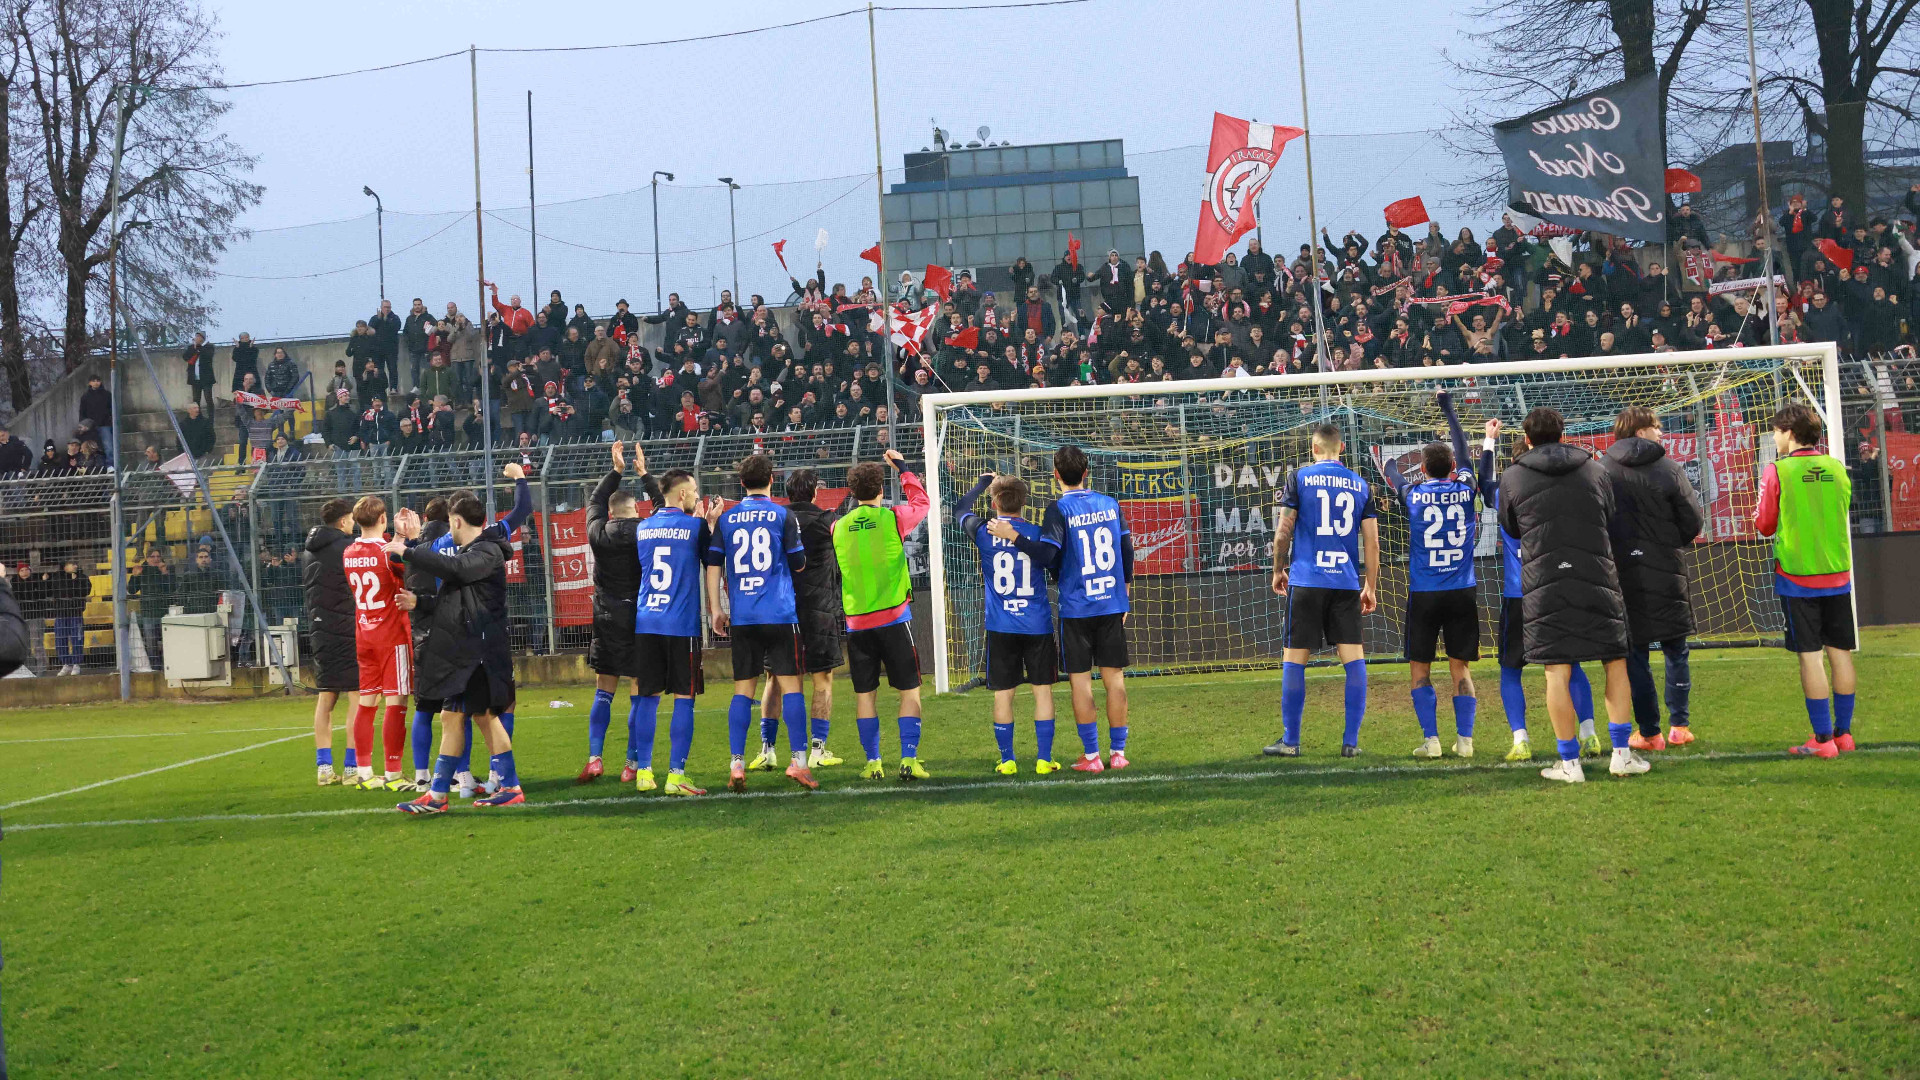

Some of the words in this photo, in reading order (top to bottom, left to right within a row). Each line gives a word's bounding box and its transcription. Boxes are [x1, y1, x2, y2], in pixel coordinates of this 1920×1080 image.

[1304, 475, 1362, 493] MARTINELLI
[1412, 490, 1471, 505] POLEDRI
[728, 511, 777, 524] CIUFFO
[1068, 508, 1117, 528] MAZZAGLIA
[1316, 489, 1355, 537] 13
[1423, 504, 1467, 548] 23
[344, 556, 378, 568] RIBERO
[650, 546, 673, 592] 5
[732, 527, 772, 574] 28
[1078, 527, 1116, 576] 18
[349, 570, 386, 611] 22
[992, 551, 1034, 597] 81
